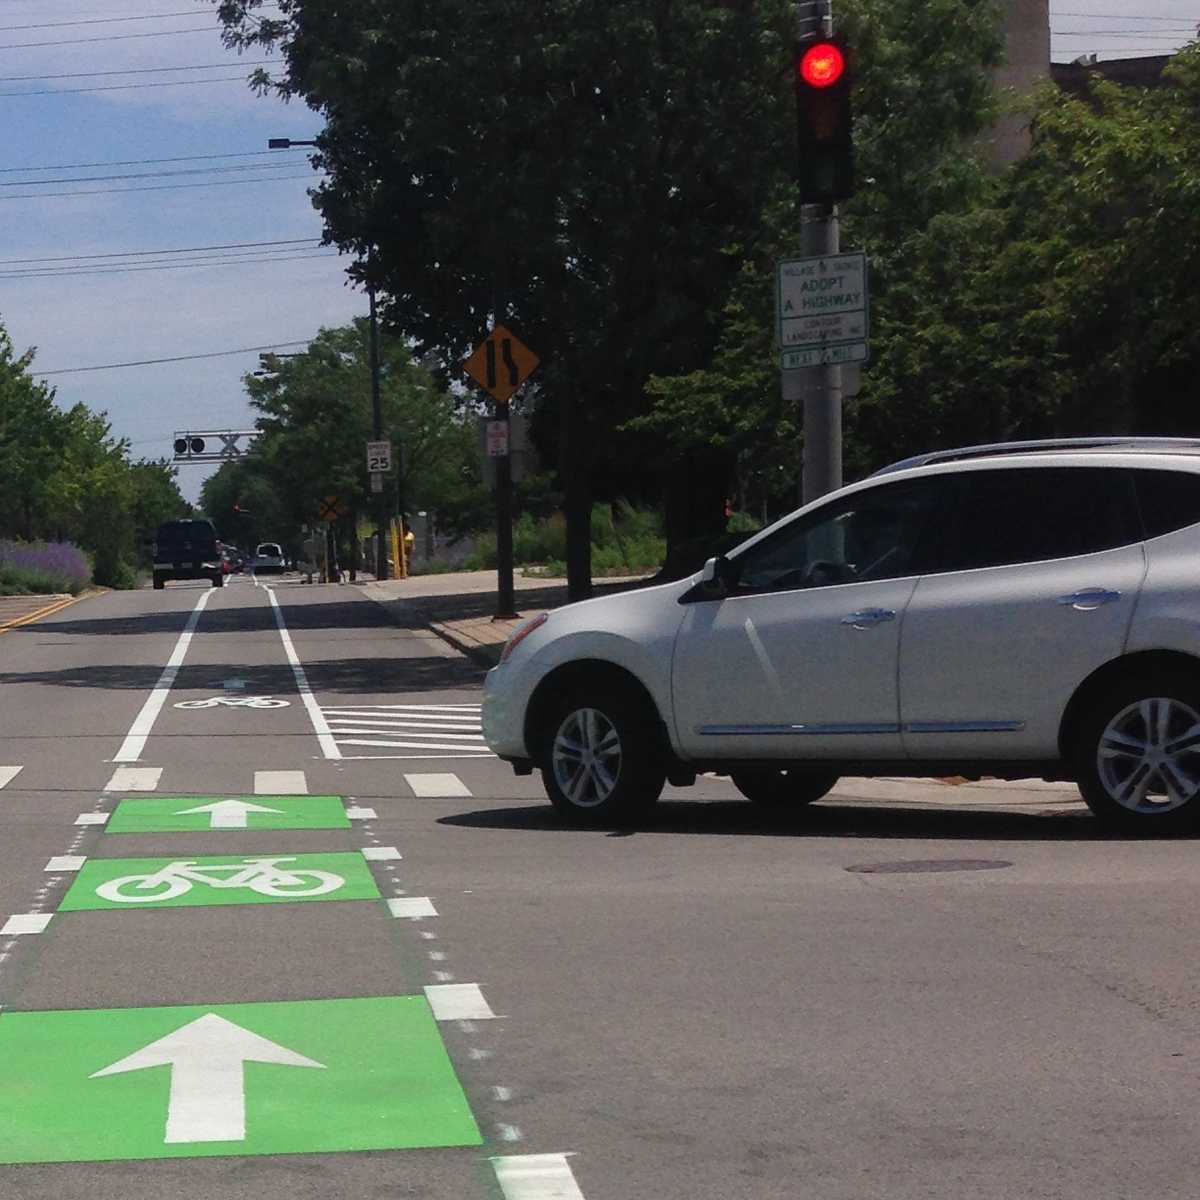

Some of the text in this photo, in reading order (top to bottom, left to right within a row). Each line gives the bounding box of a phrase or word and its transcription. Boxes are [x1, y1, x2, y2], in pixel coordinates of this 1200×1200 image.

[801, 276, 844, 291] ADOPT
[784, 293, 861, 312] A HIGHWAY
[370, 457, 389, 469] 25
